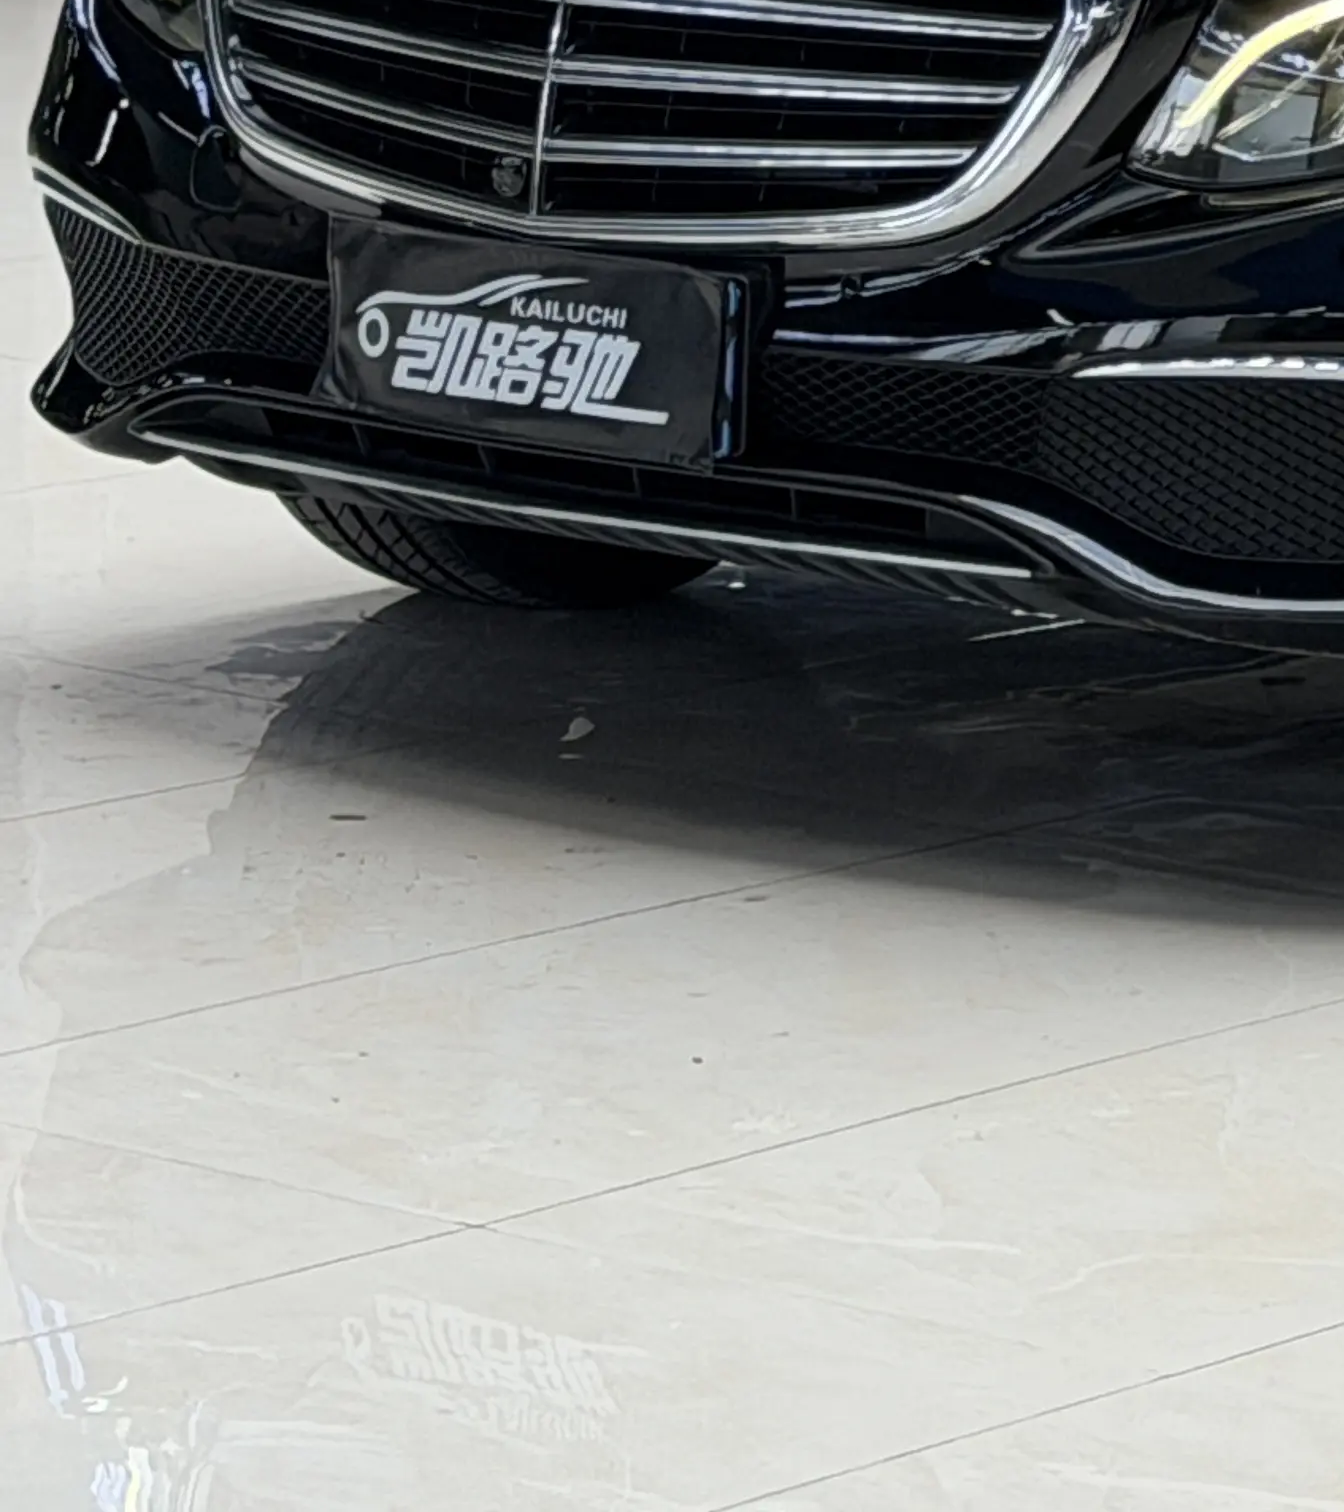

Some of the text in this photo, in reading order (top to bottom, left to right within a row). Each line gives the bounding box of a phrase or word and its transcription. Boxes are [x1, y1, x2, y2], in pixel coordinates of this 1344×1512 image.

[509, 295, 628, 330] KAILUCHI
[391, 308, 669, 425] 凯路驰
